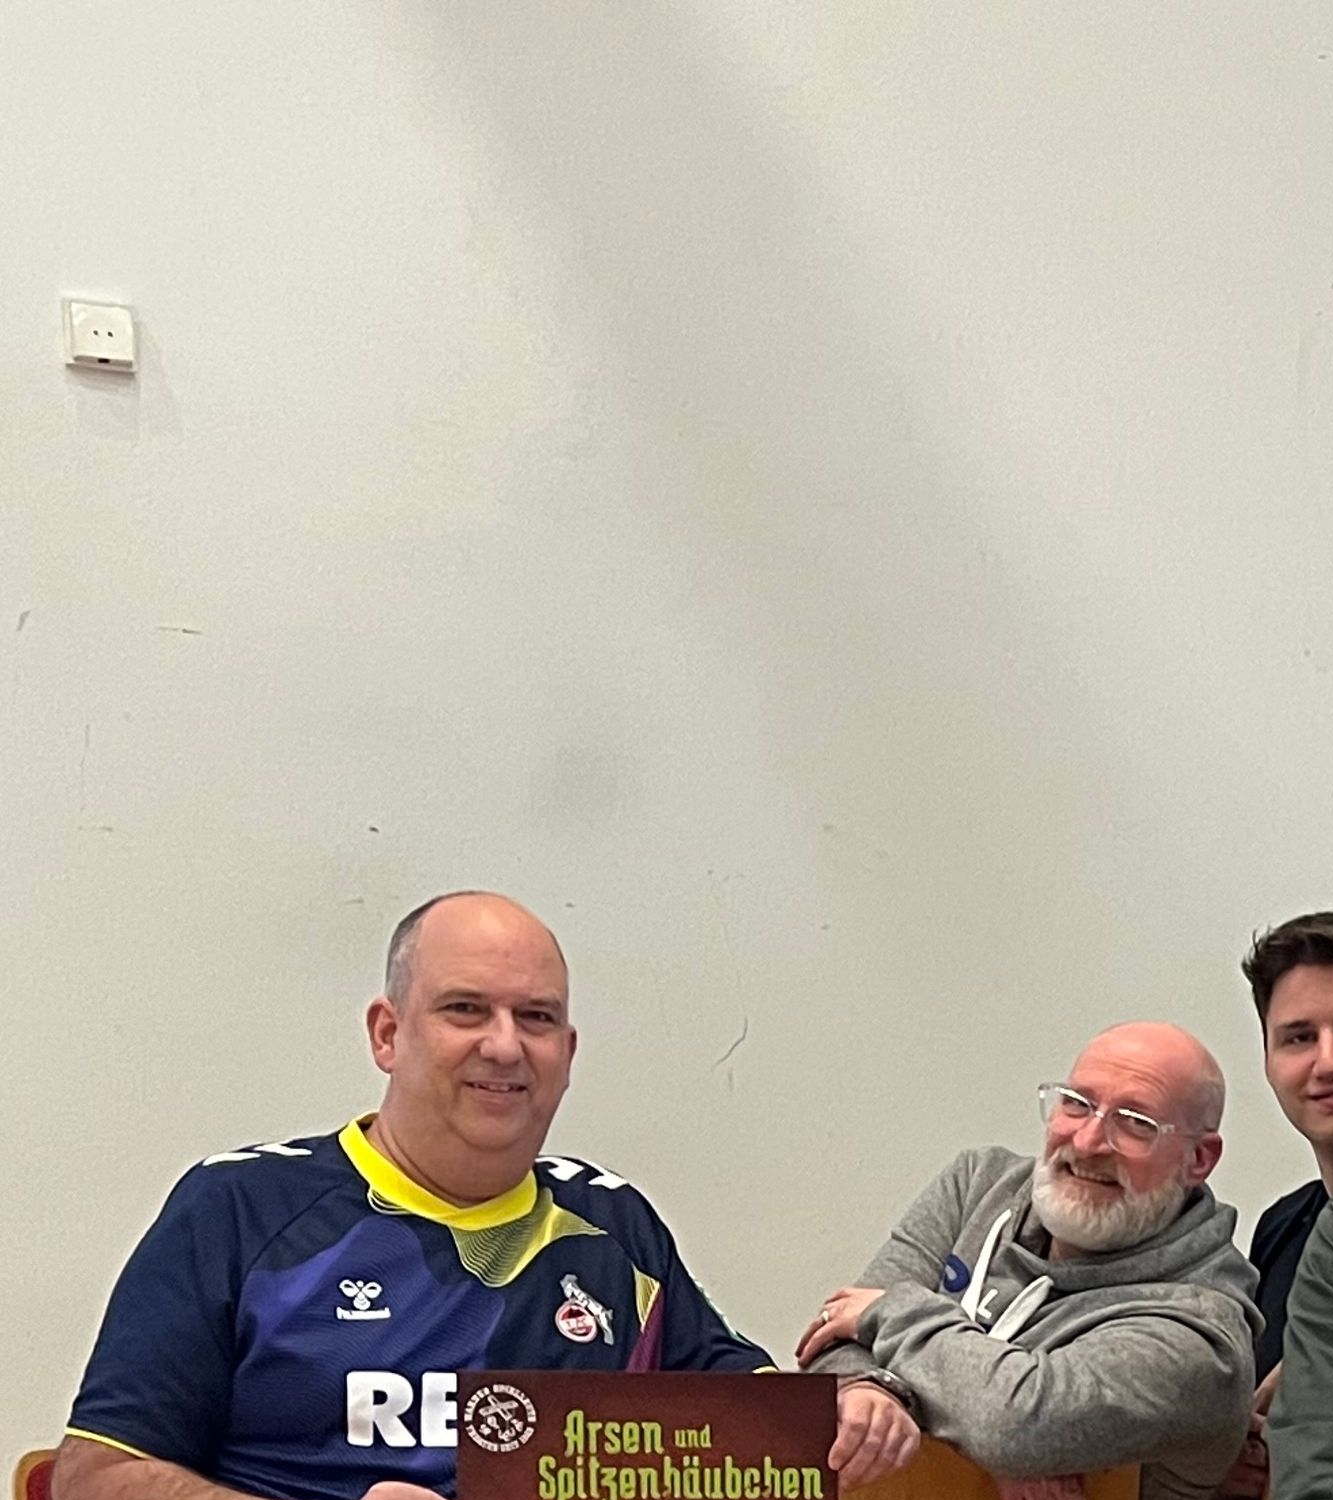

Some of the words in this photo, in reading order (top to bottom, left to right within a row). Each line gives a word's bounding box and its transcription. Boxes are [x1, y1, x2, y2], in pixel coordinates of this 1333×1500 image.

[346, 1371, 458, 1447] RE
[564, 1409, 665, 1457] Arsen
[674, 1423, 712, 1448] und
